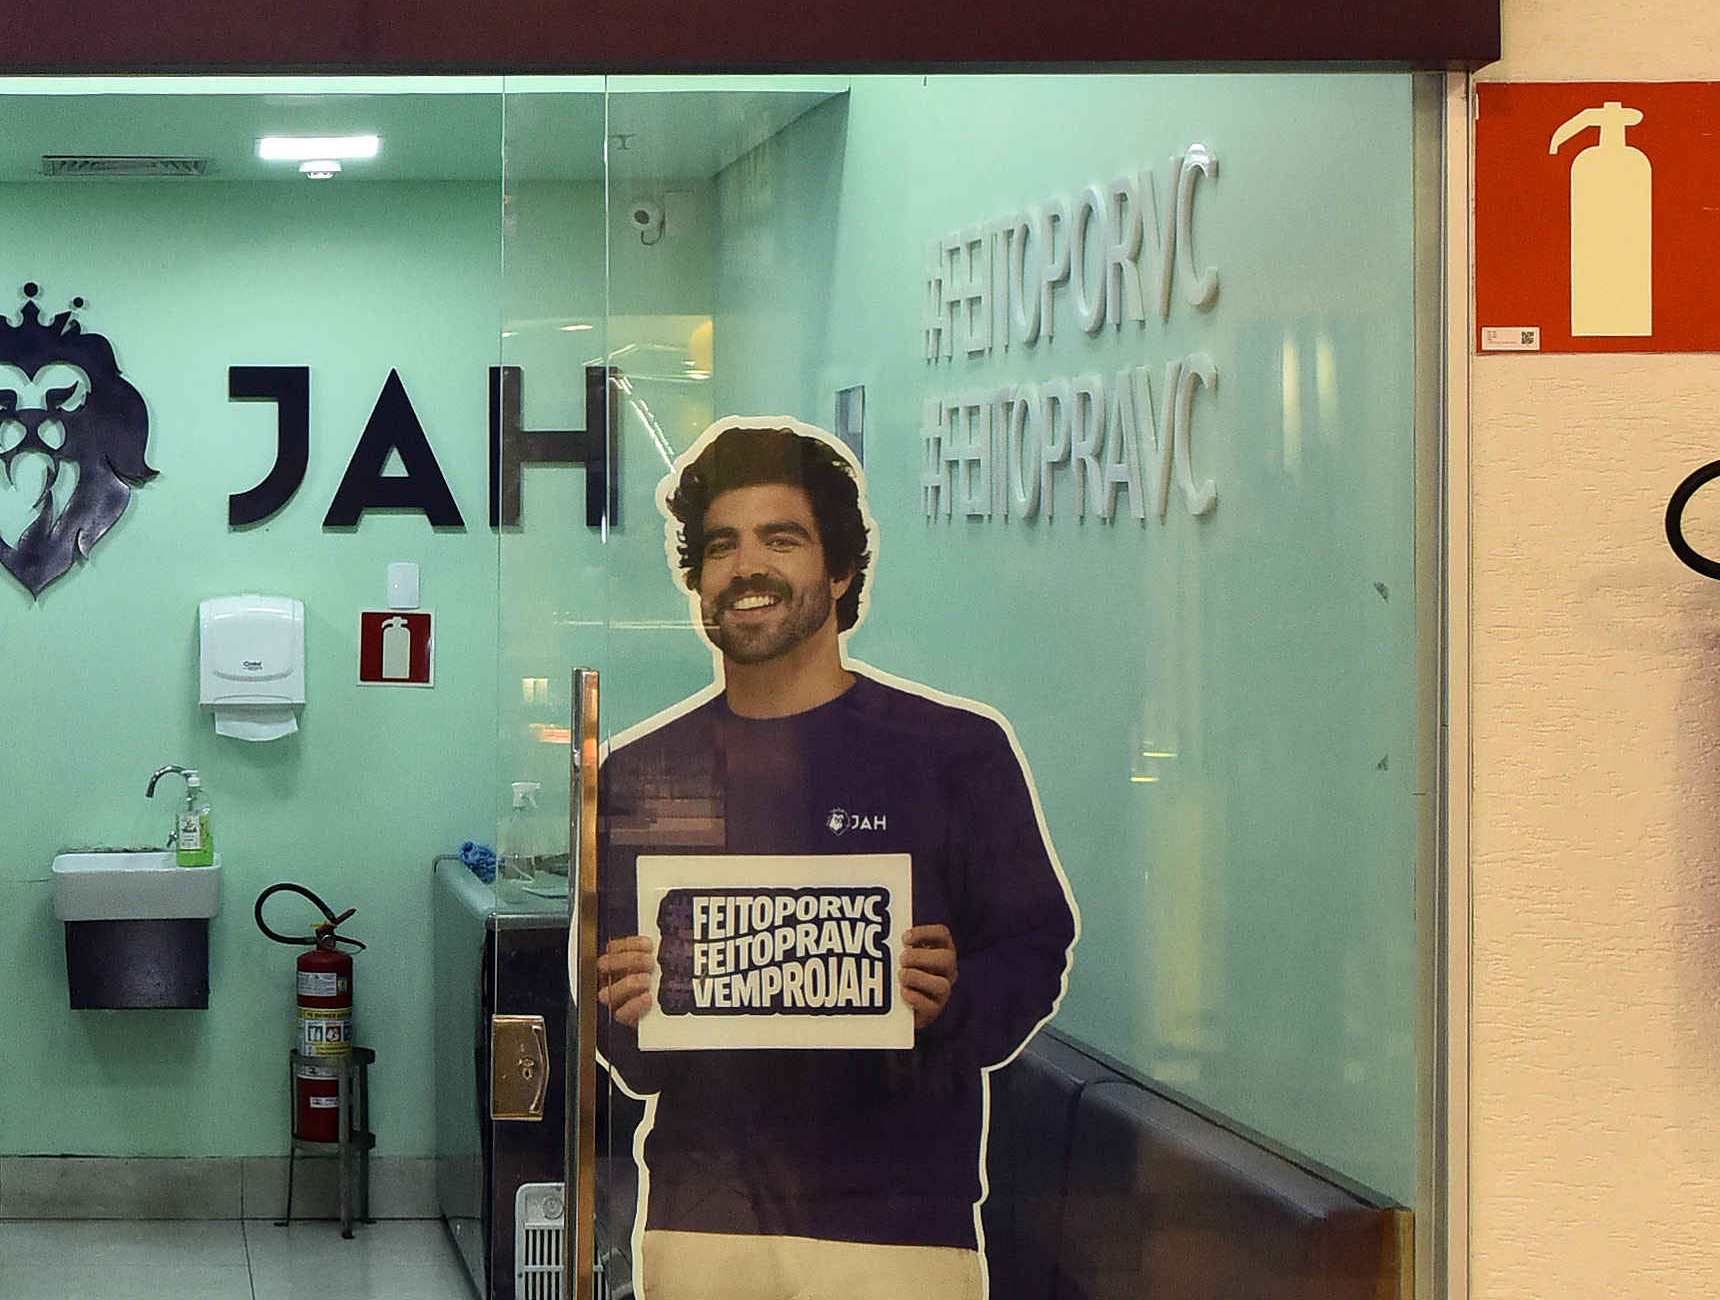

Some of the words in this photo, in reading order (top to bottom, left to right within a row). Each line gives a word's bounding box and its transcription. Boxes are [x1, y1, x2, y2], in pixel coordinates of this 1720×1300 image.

[921, 141, 1219, 363] #FEITOPORVC
[228, 366, 618, 530] JAH
[919, 353, 1218, 521] #FEITOPRAVC
[851, 815, 887, 830] JAH
[693, 895, 883, 940] FEITOPORVC
[693, 920, 883, 976] FEITOPRAVC
[692, 957, 884, 1008] VEMPROJAH
